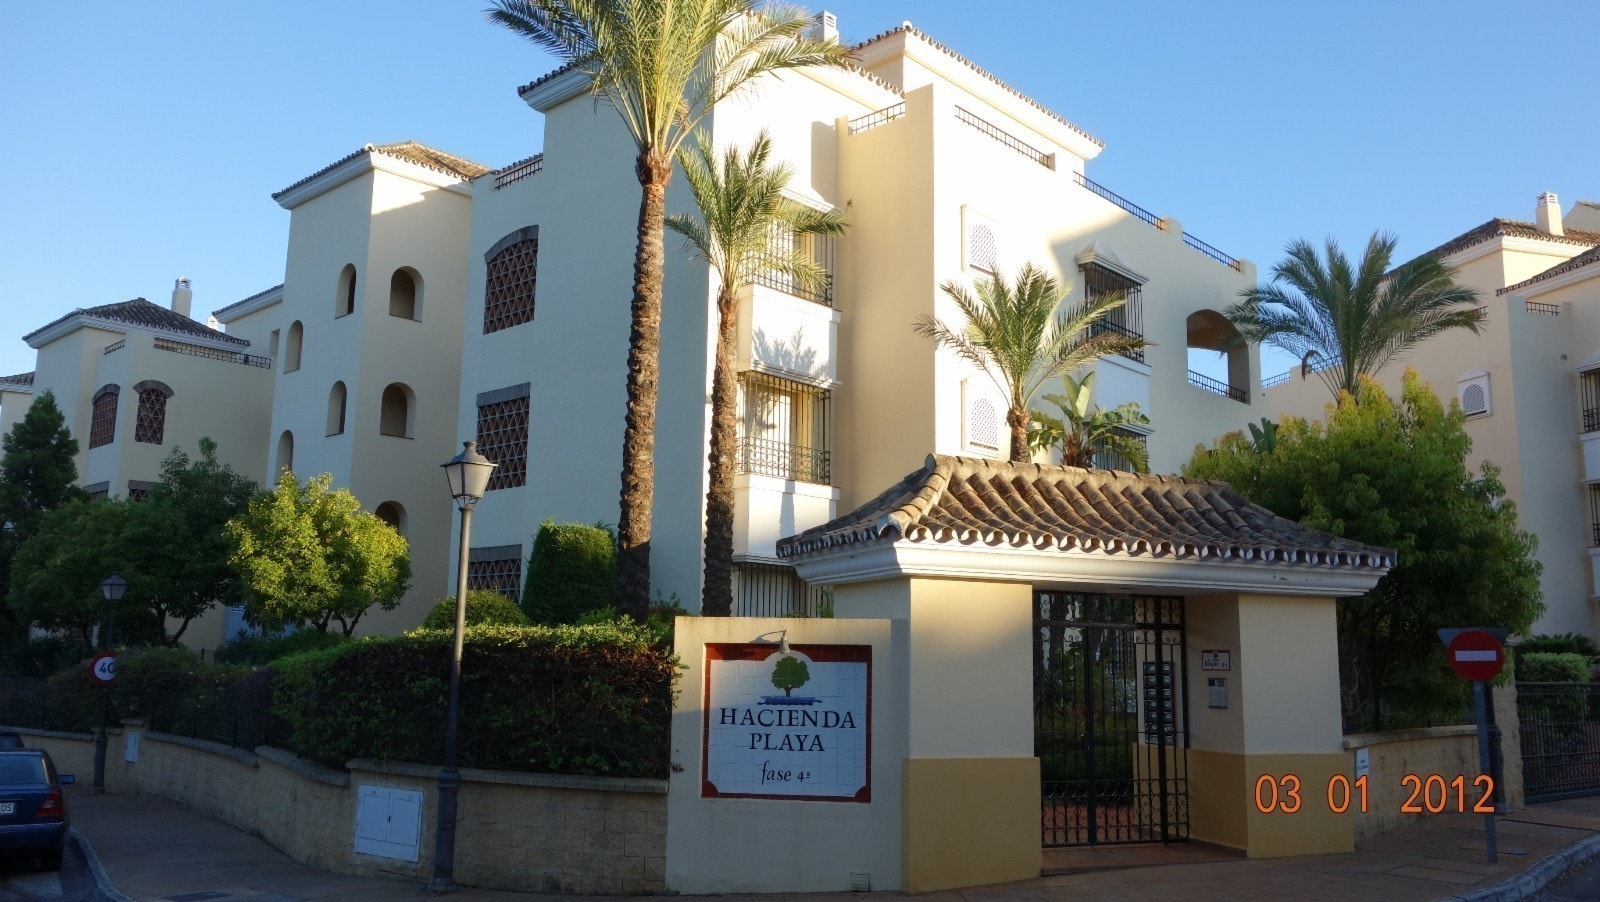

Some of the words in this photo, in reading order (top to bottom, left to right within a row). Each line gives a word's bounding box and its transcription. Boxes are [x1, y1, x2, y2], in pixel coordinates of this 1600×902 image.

[719, 707, 857, 729] HACIENDA
[748, 732, 825, 752] PLAYA
[761, 760, 792, 786] fase
